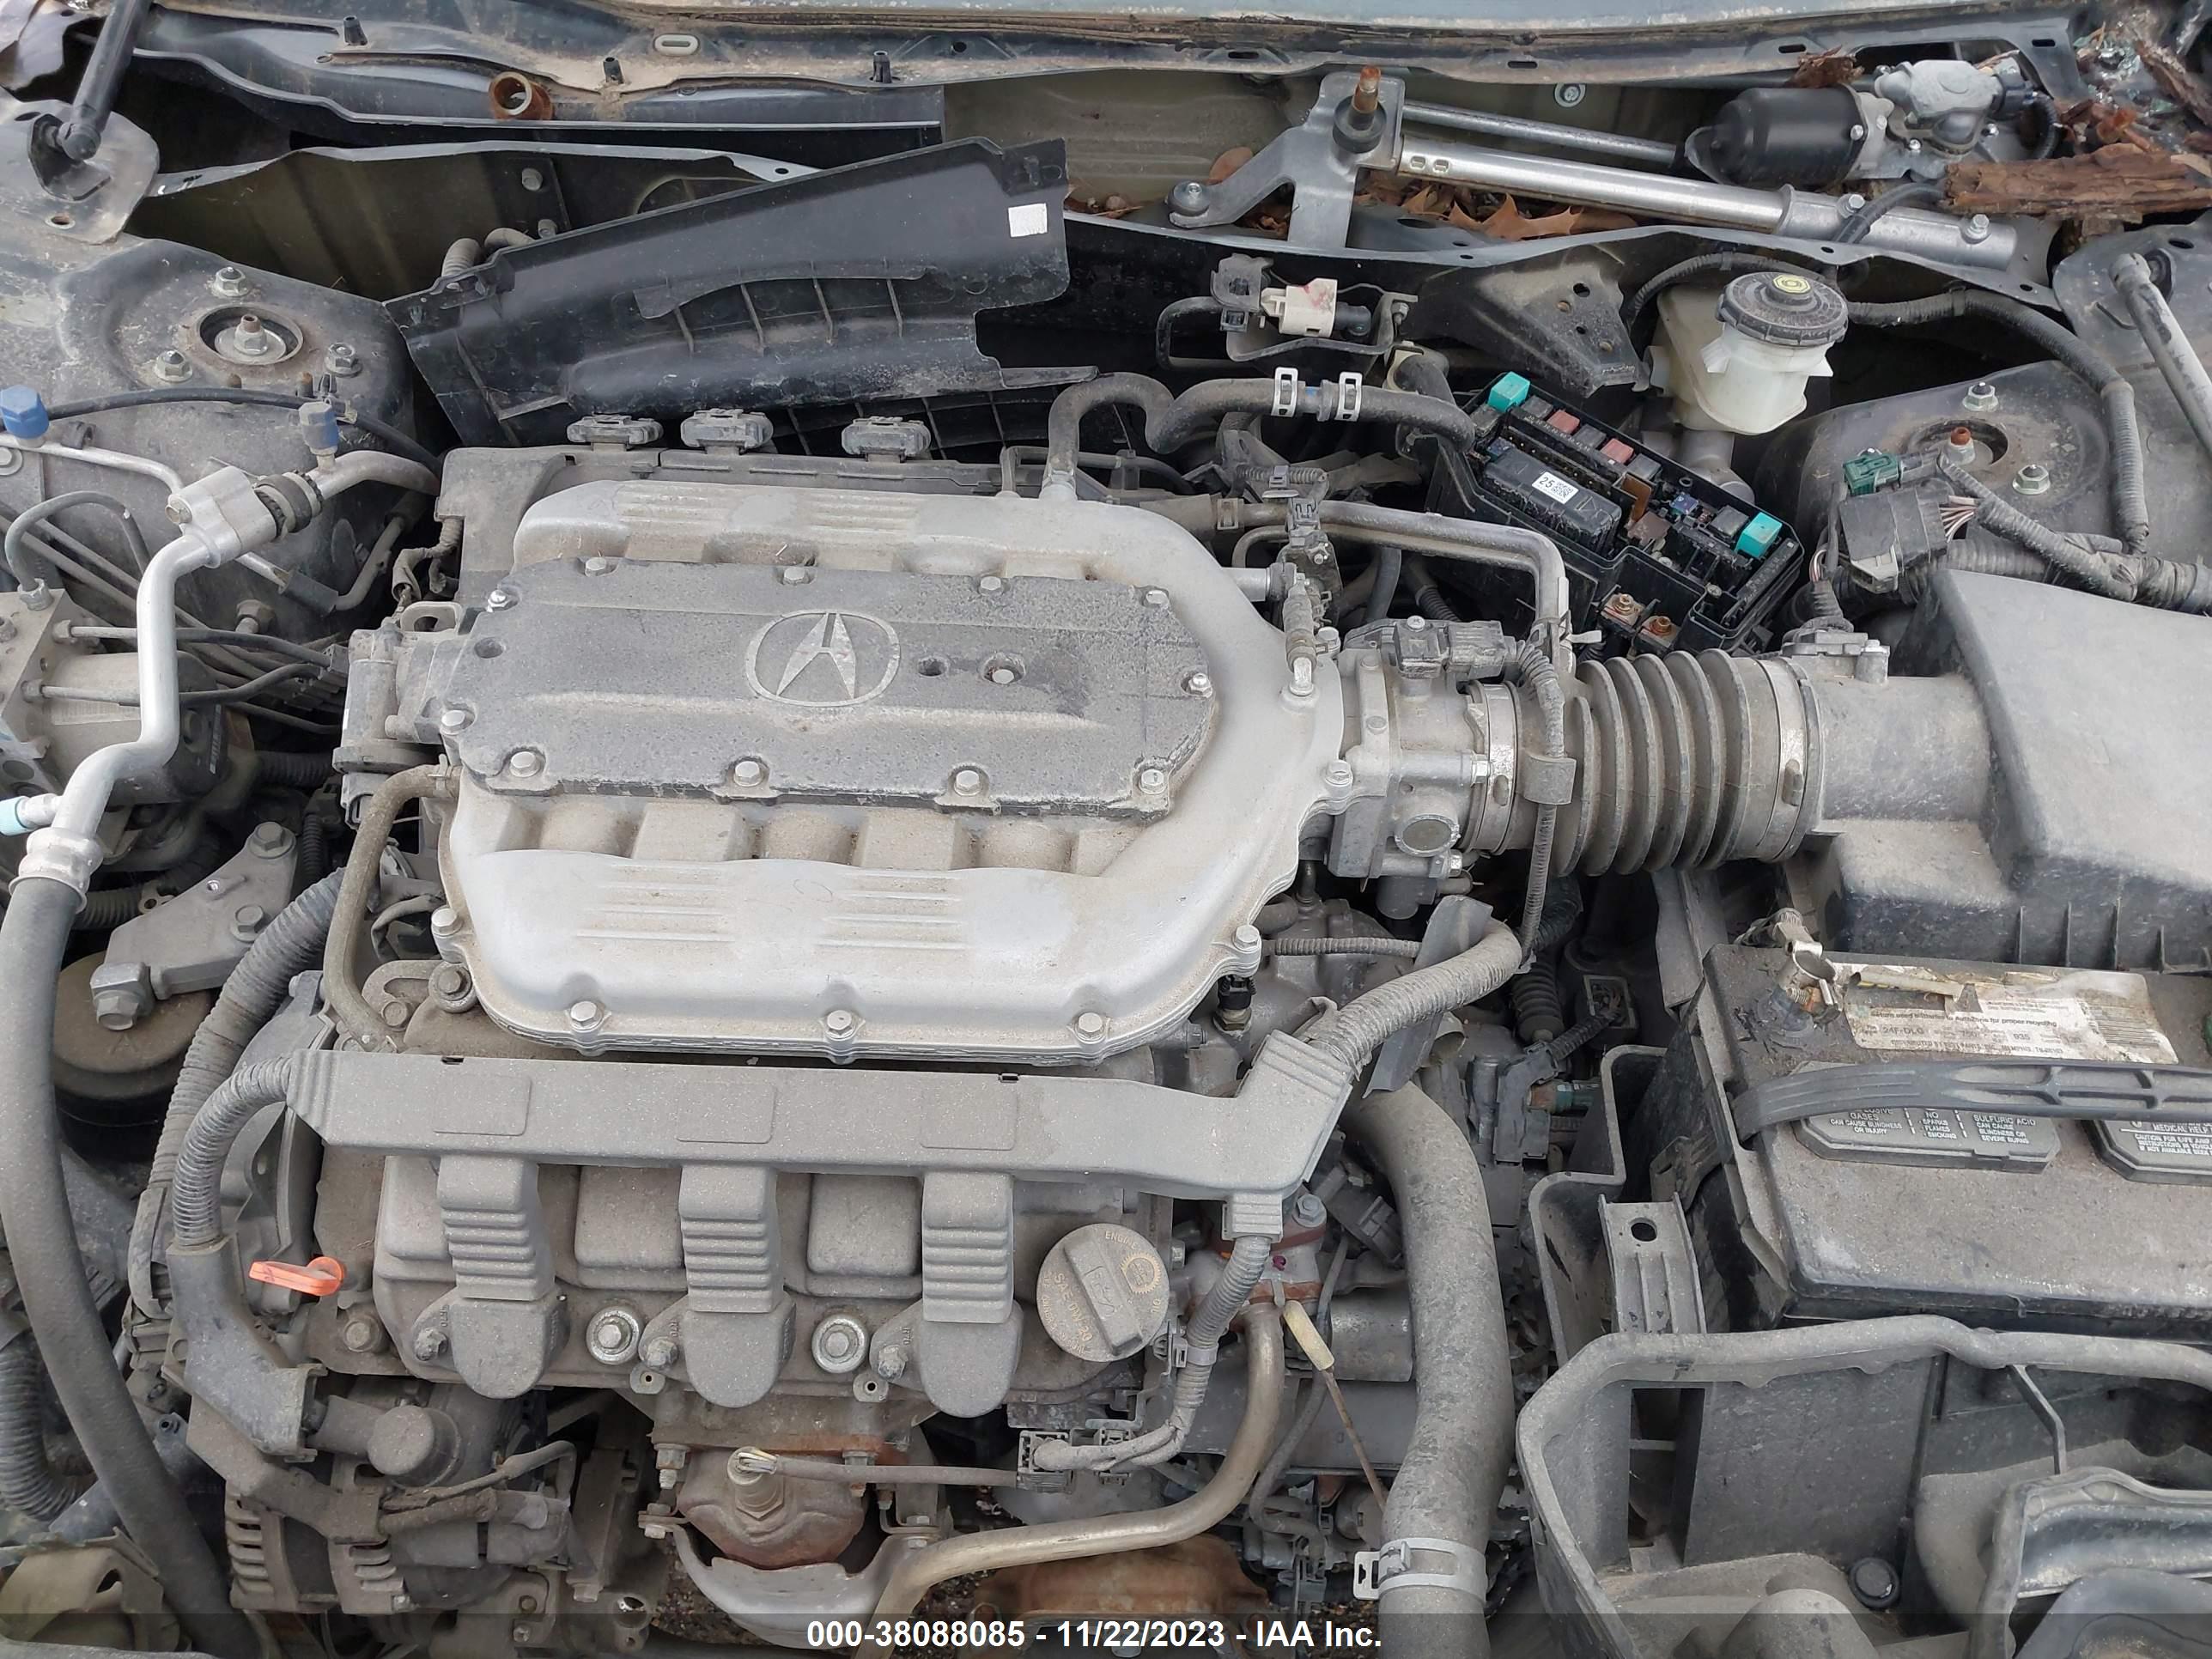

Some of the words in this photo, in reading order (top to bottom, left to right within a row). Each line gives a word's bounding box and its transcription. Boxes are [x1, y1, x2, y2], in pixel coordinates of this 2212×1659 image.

[1850, 1112, 1880, 1121] GASES
[1972, 1114, 2014, 1125] SULFURIC
[1978, 1128, 2014, 1137] BLINDNESS
[2152, 1123, 2188, 1133] MEDICAL
[2189, 1126, 2209, 1134] HELP
[1104, 1231, 1139, 1250] ENGINE
[1054, 1273, 1073, 1302] SAE
[1150, 1298, 1162, 1314] OIL
